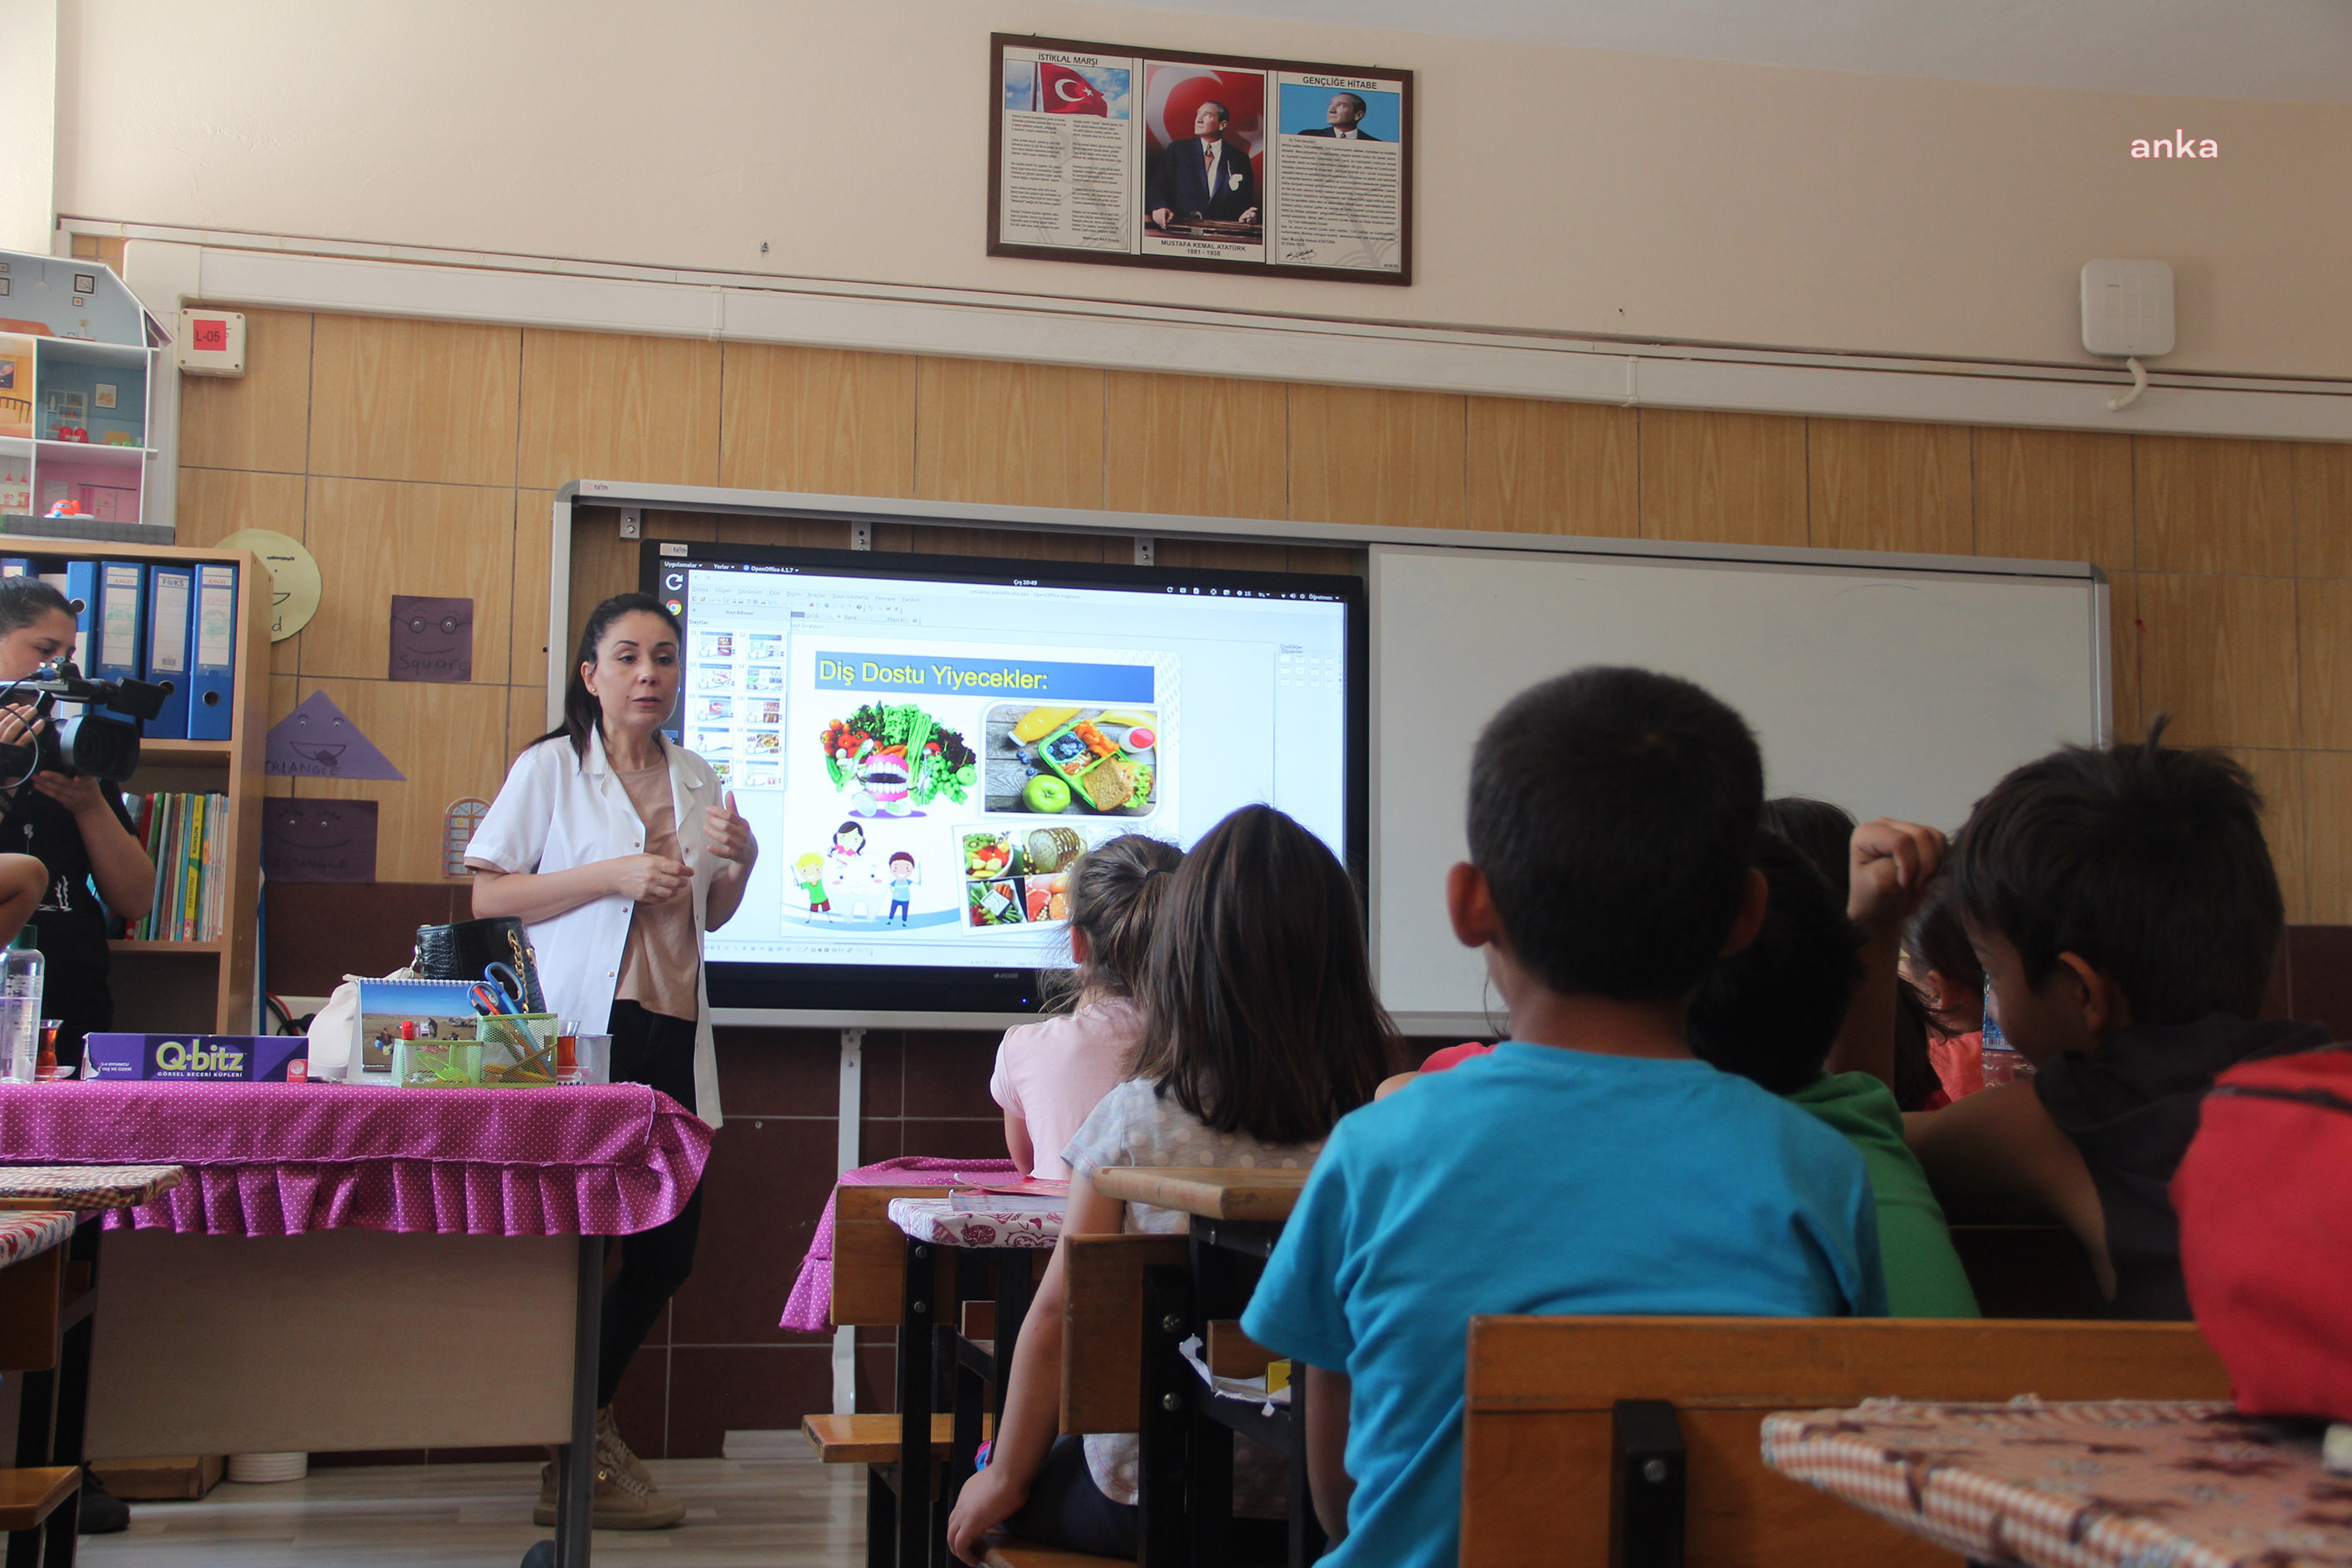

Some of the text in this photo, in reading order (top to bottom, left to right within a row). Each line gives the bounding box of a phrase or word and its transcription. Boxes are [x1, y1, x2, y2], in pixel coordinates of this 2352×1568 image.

[1038, 52, 1098, 67] İSTİKLAL MARŞI
[1303, 75, 1377, 90] GENÇLİĞE HİTABE
[1161, 240, 1191, 248] MUSTAFA
[1193, 241, 1215, 250] KEMAL
[196, 330, 221, 343] L-05
[664, 561, 697, 569] Uygulamalar
[397, 655, 468, 676] Square
[820, 659, 1049, 690] Diş Dostu Yiyecekler:
[265, 760, 341, 776] TRIANGLE
[184, 928, 191, 937] 3
